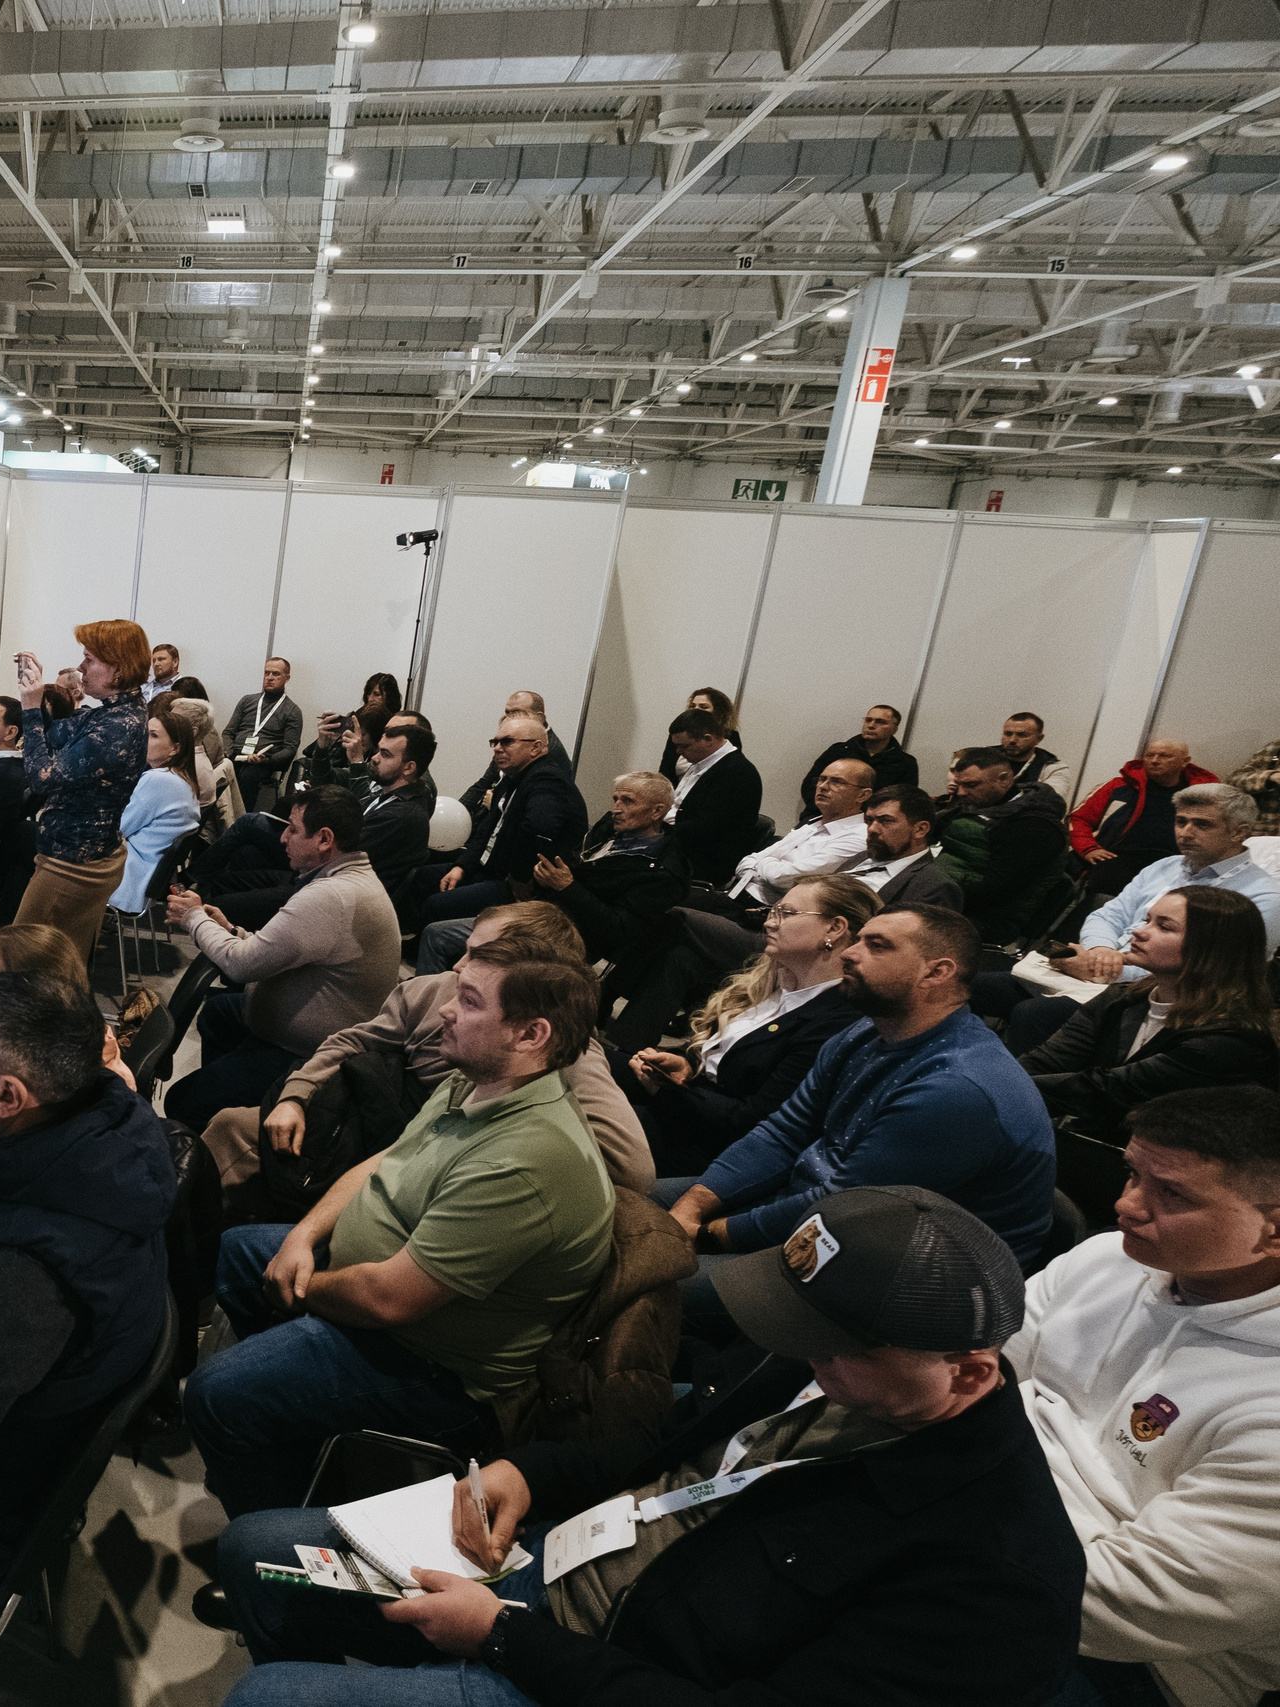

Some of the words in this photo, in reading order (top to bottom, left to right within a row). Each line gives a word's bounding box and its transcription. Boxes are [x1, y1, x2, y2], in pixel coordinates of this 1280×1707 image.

[180, 256, 192, 268] 18
[456, 255, 467, 268] 17
[739, 256, 752, 269] 16
[1050, 259, 1065, 272] 15
[821, 1237, 835, 1253] BEAR
[687, 1482, 715, 1495] TRADE
[692, 1487, 716, 1501] FRUIT
